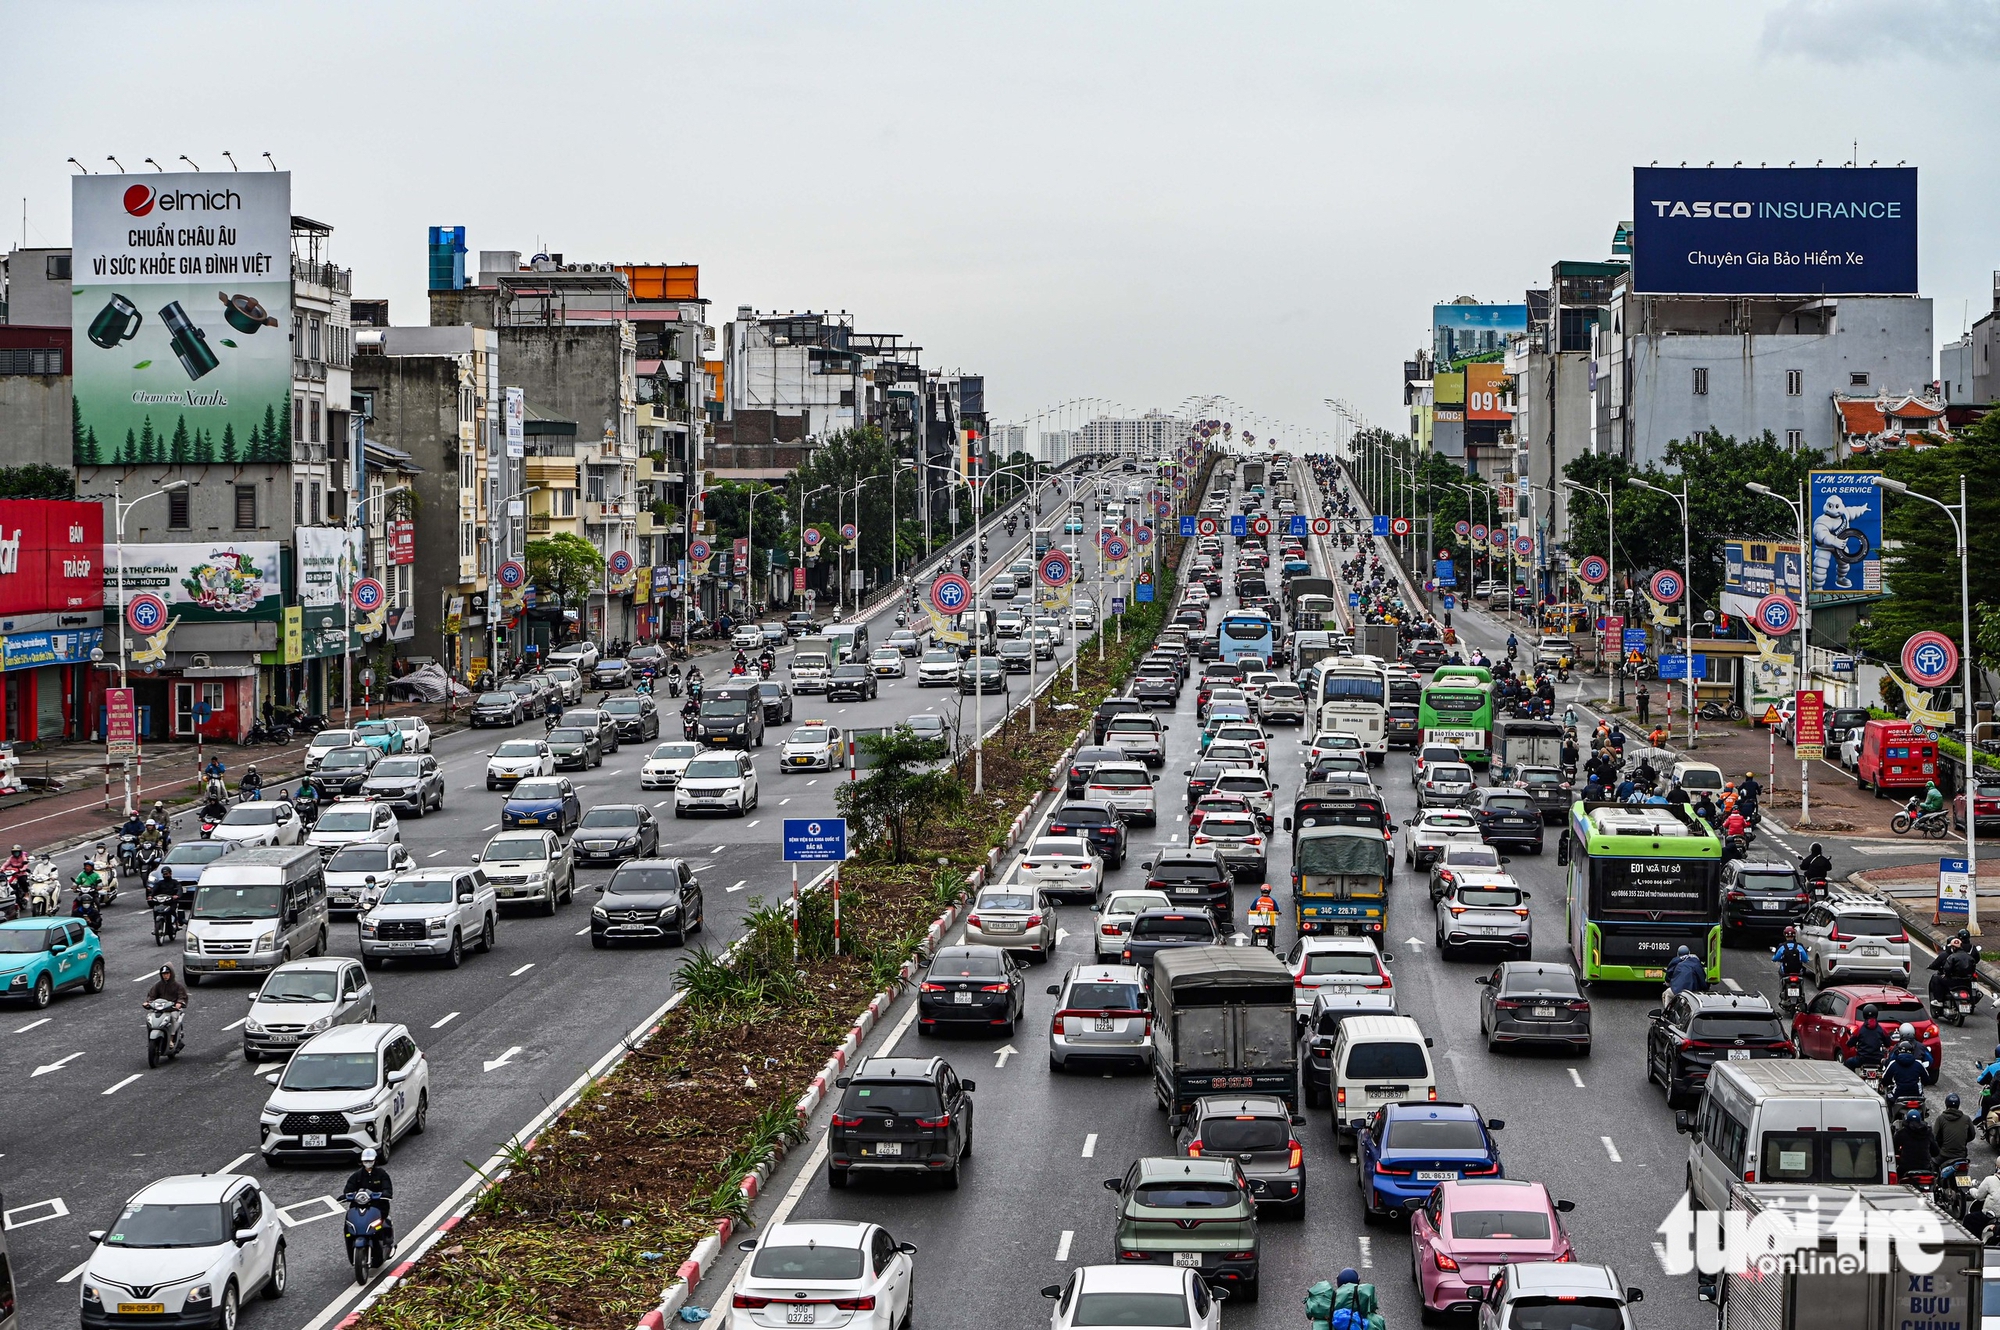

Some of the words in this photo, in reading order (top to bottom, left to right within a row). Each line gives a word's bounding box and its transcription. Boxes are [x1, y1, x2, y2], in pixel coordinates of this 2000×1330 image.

[158, 188, 241, 211] elmich
[1651, 201, 1752, 218] TASCO
[1758, 202, 1901, 218] INSURANCE
[128, 222, 174, 246] CHUẨN
[178, 225, 214, 246] CHÂU
[218, 225, 236, 246] ÂU
[93, 258, 106, 276] VÌ
[110, 255, 136, 276] SỨC
[140, 252, 176, 274] KHỎE
[180, 257, 201, 274] GIA
[205, 254, 238, 274] ĐÌNH
[242, 252, 272, 276] VIỆT
[1688, 251, 1742, 269] Chuyên
[1746, 252, 1770, 266] Gia
[1774, 250, 1800, 266] Bảo
[1804, 248, 1842, 266] Hiểm
[1846, 252, 1864, 266] Xe
[1204, 522, 1212, 531] 60
[1257, 522, 1266, 531] 60
[1317, 522, 1325, 531] 60
[1397, 522, 1405, 531] 40
[129, 564, 153, 576] THỰC
[1630, 864, 1644, 873] E01
[1908, 1274, 1934, 1292] XE
[1909, 1294, 1950, 1314] BƯU
[788, 1314, 813, 1322] 037.85
